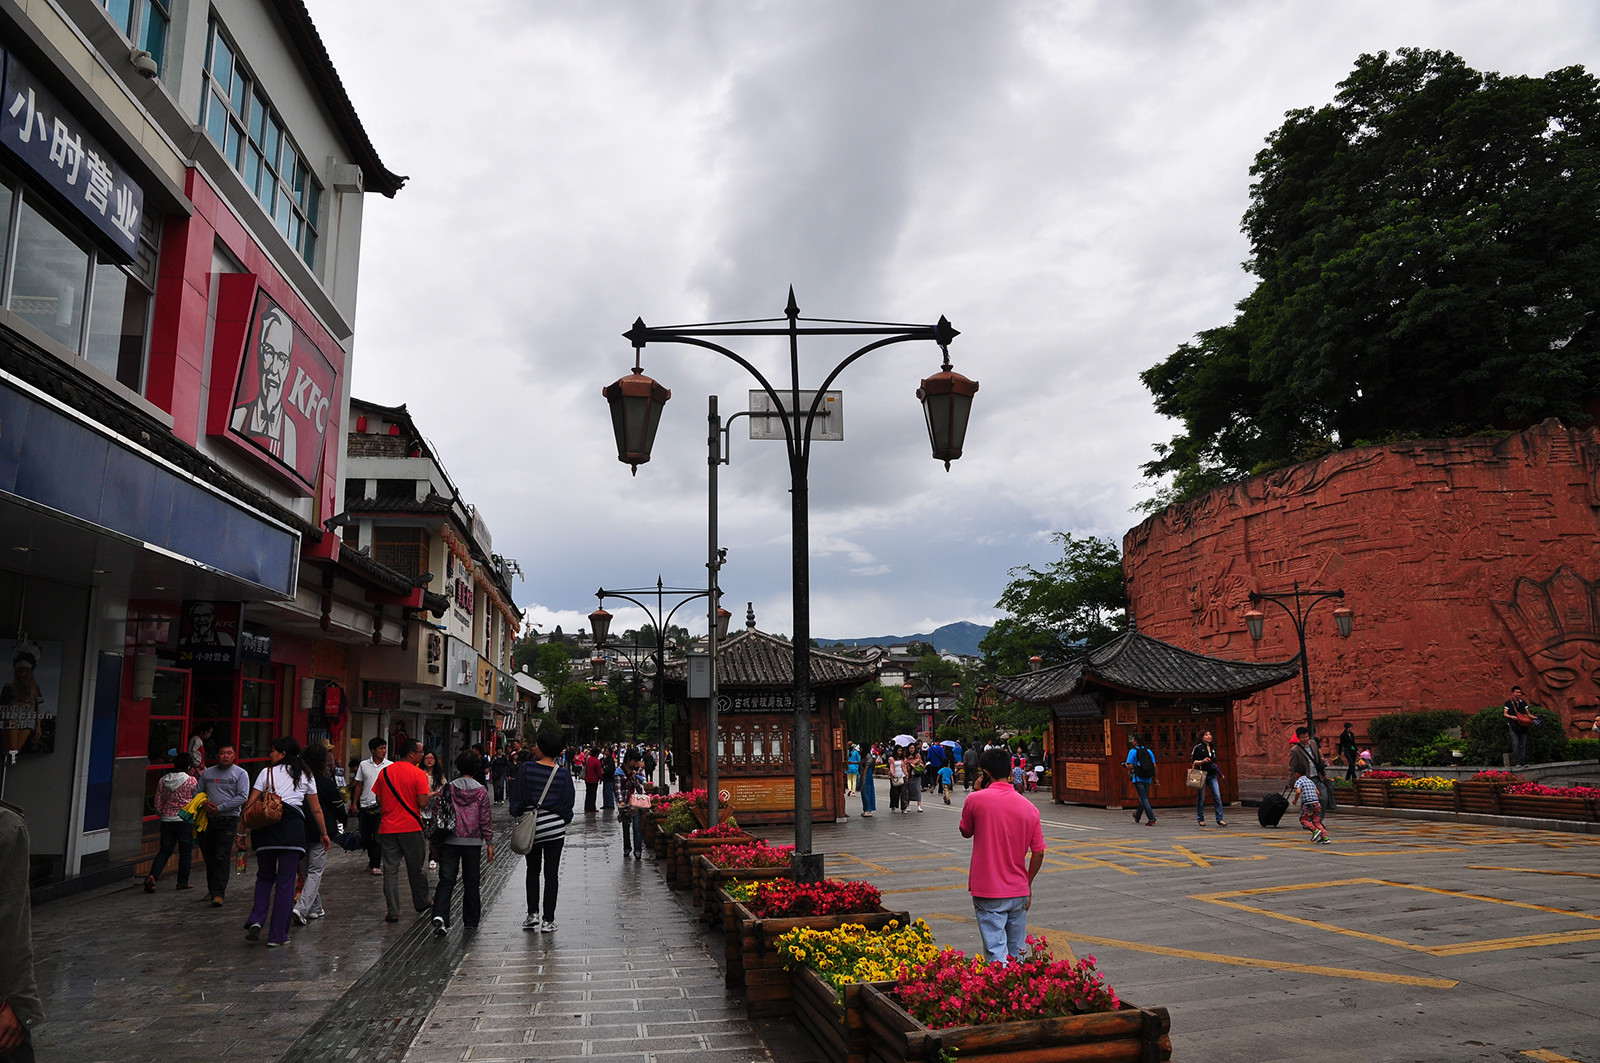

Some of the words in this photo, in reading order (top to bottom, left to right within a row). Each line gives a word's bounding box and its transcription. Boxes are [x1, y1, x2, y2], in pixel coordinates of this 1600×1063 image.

[8, 86, 139, 244] 小时营业
[287, 366, 330, 433] KFC
[214, 619, 237, 629] KFC
[179, 650, 193, 661] 24
[195, 652, 231, 662] 小时营业
